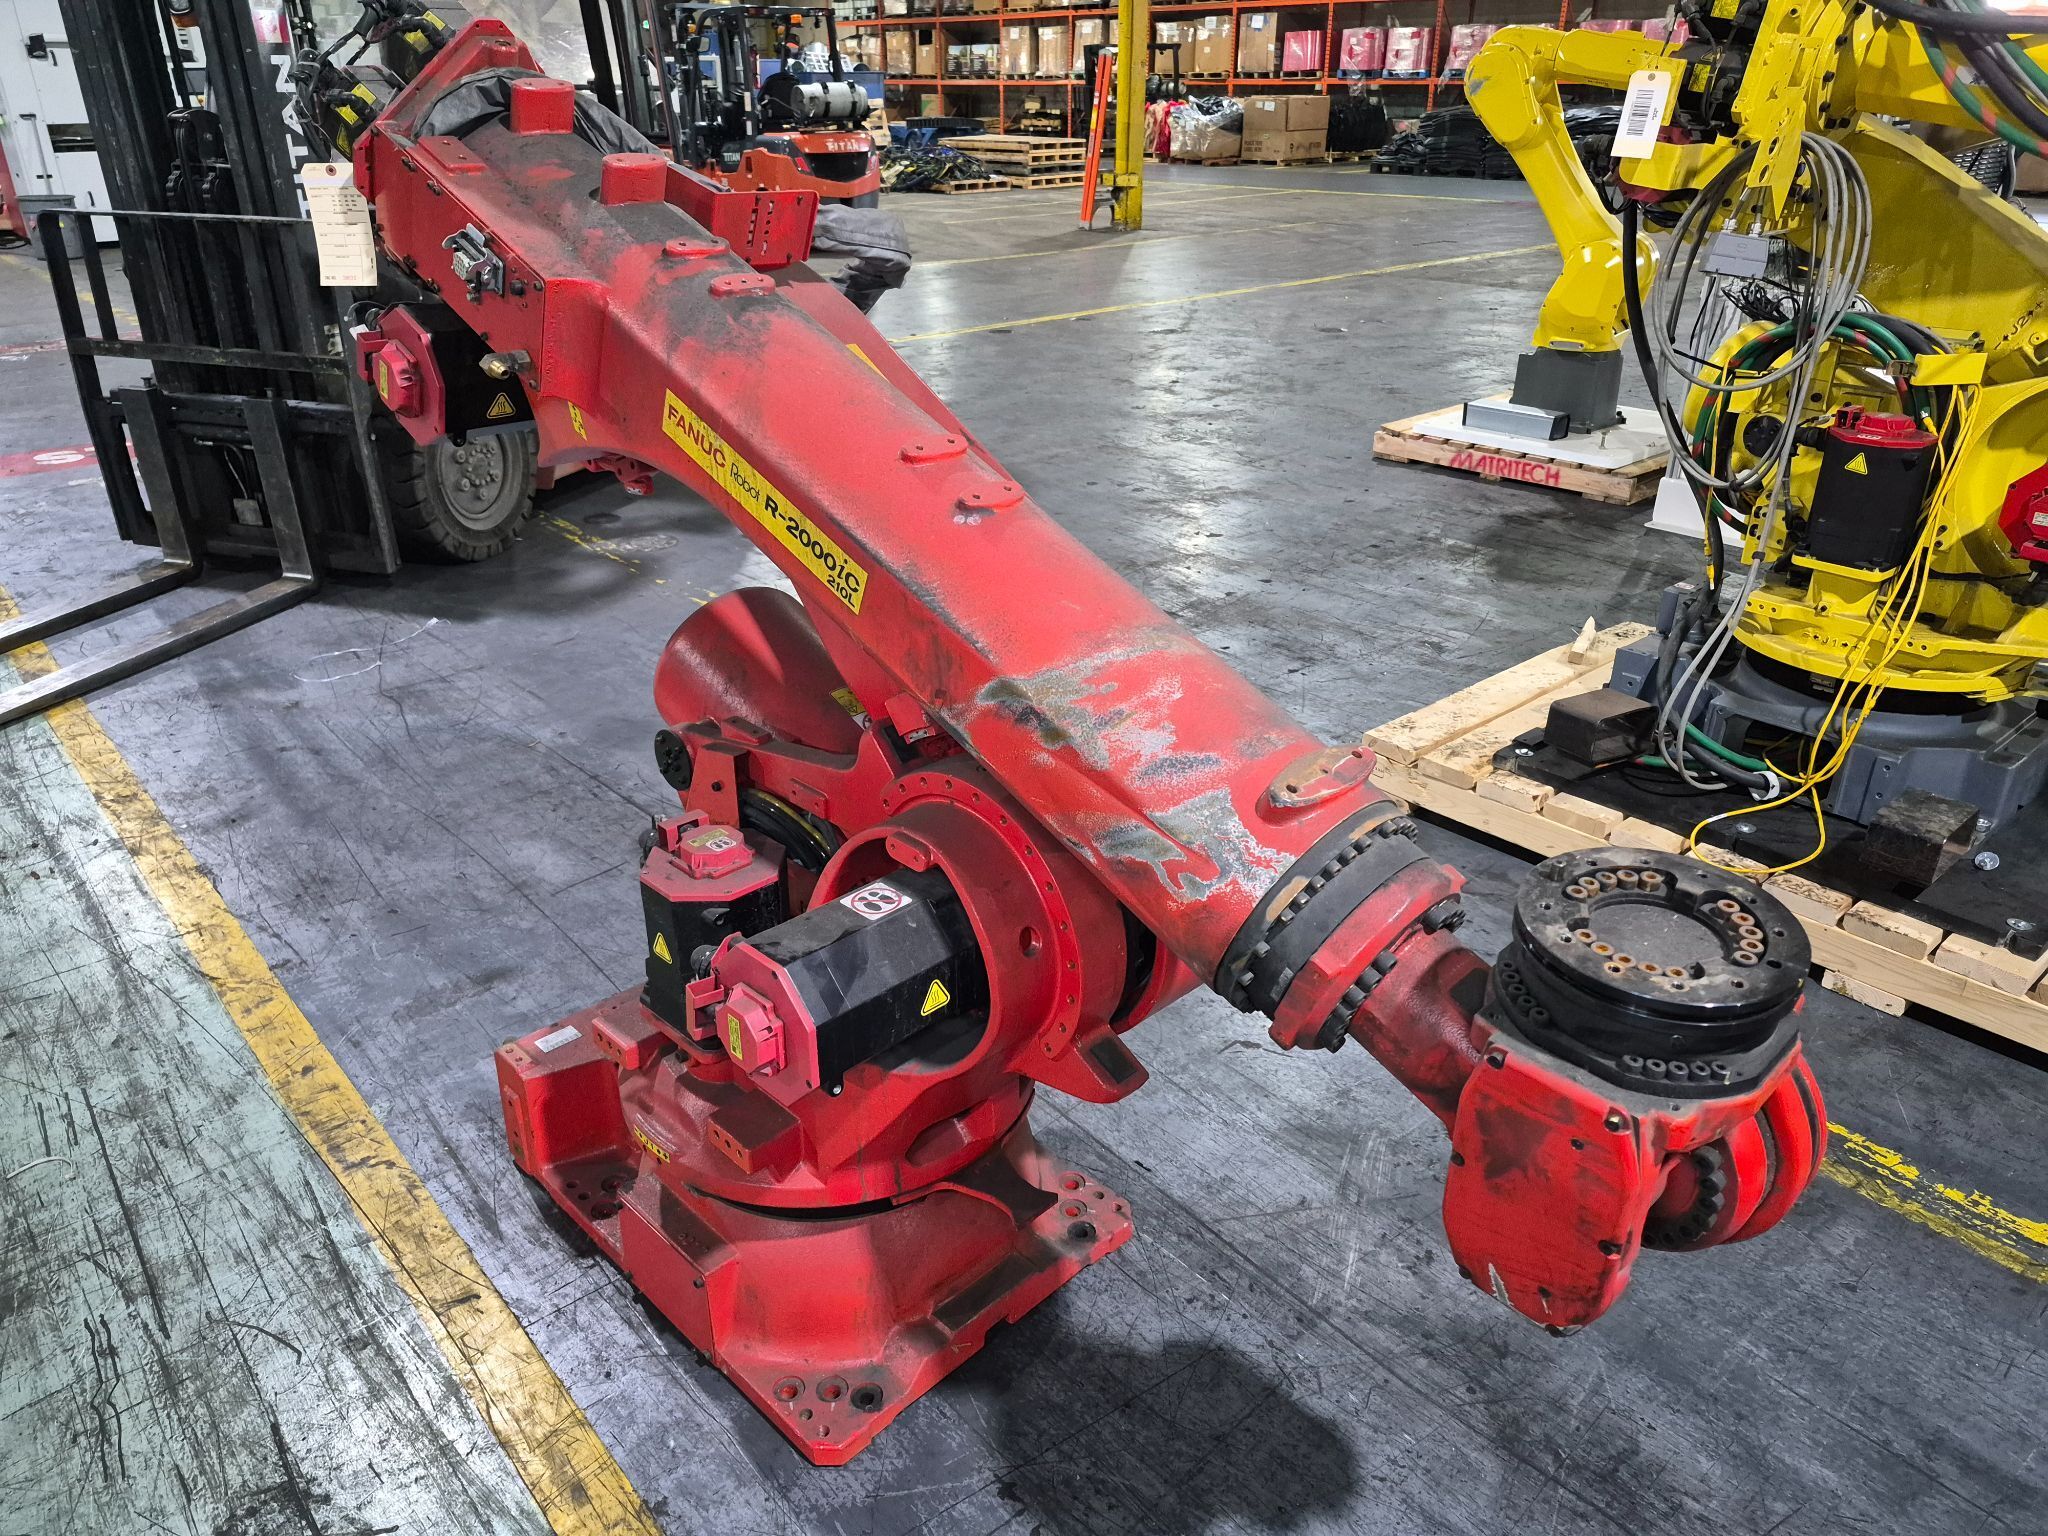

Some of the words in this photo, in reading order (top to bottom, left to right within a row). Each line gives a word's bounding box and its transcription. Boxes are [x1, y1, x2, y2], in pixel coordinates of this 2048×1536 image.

[723, 152, 740, 162] TITAN
[825, 138, 861, 151] TITAN
[1449, 451, 1560, 486] MATRITECH
[667, 403, 726, 468] FANUC
[730, 462, 760, 502] Robot
[765, 495, 860, 593] R-2000iC
[826, 574, 856, 607] 210L
